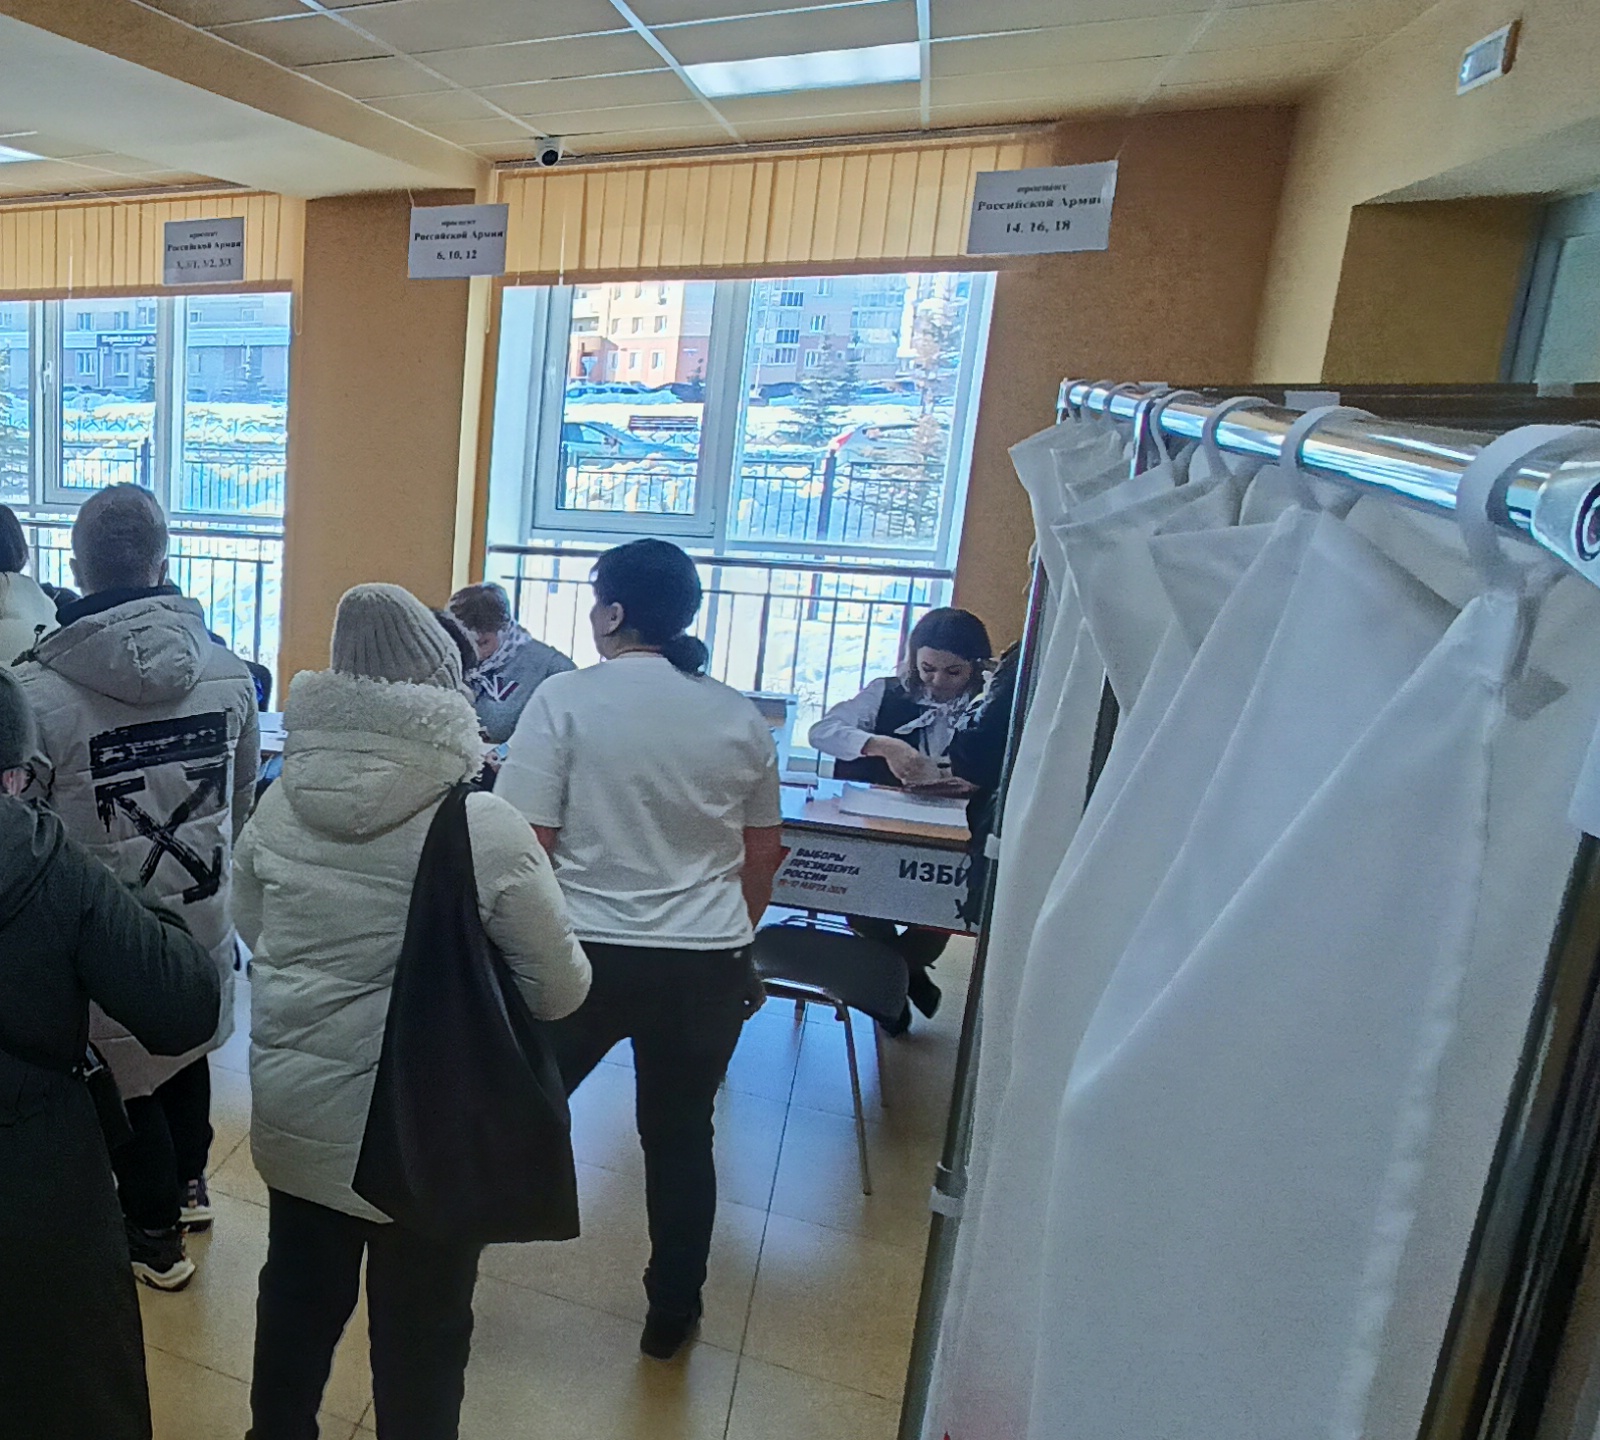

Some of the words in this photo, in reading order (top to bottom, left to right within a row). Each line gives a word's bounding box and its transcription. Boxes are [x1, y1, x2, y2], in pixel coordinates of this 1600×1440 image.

[977, 198, 1055, 212] Российской
[414, 230, 468, 241] Российской
[473, 230, 504, 241] Армии
[466, 249, 477, 260] 12
[796, 848, 847, 862] ВЫБОРЫ
[789, 858, 861, 876] ПРЕЗИДЕНТА
[782, 868, 828, 882] РОССИИ
